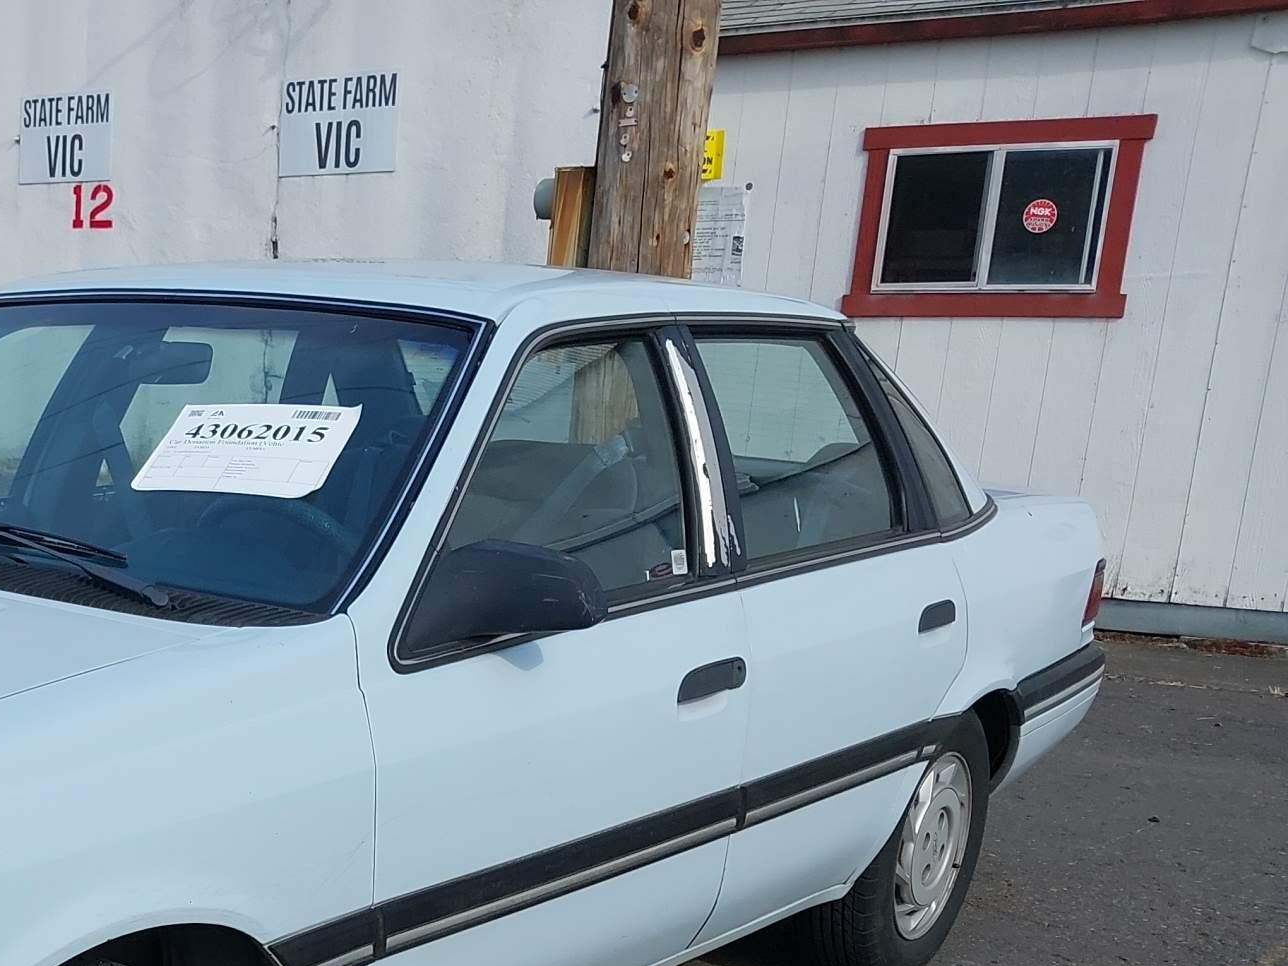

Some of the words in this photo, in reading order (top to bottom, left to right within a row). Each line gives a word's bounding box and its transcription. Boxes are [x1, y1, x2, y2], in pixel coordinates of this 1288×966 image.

[23, 97, 63, 128] STATE
[67, 94, 110, 125] FARM
[286, 77, 337, 114] STATE
[342, 73, 398, 109] FARM
[46, 134, 83, 178] VIC
[315, 120, 362, 169] VIC
[72, 184, 114, 229] 12
[1030, 206, 1053, 216] NGK
[185, 423, 330, 443] 43062015
